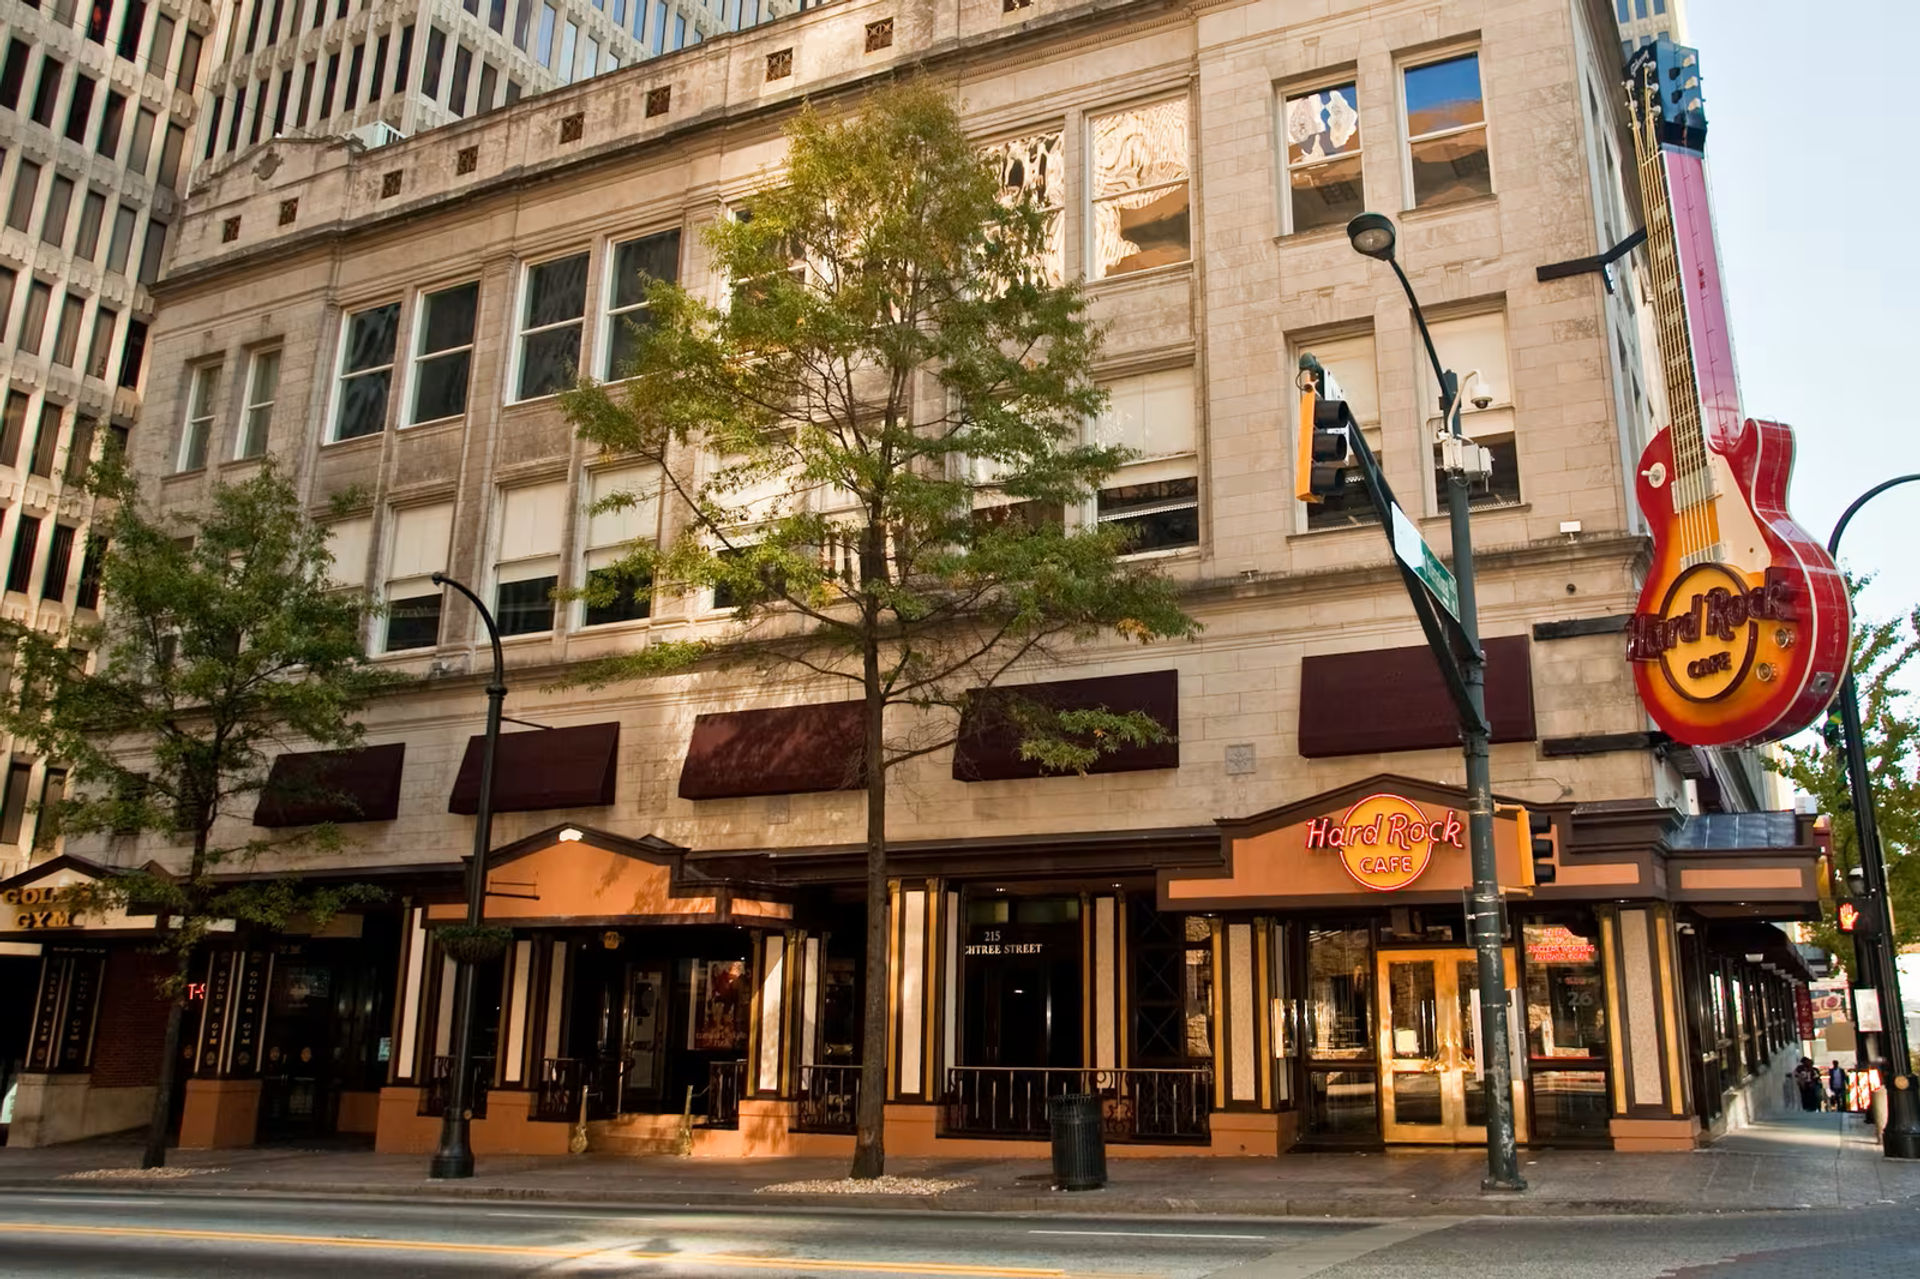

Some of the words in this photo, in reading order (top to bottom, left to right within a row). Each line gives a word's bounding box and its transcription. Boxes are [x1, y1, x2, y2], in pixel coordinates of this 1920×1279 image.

[1625, 594, 1703, 662] Hard
[1704, 566, 1792, 641] Rock
[1687, 652, 1732, 679] CAFE
[1306, 814, 1382, 849] Hard
[1388, 810, 1465, 850] Rock
[1360, 856, 1413, 874] CAFE
[14, 911, 74, 928] GYM
[984, 931, 1001, 942] 215
[1004, 943, 1043, 954] STREET
[210, 1022, 220, 1045] GYM
[241, 1022, 253, 1045] GYM
